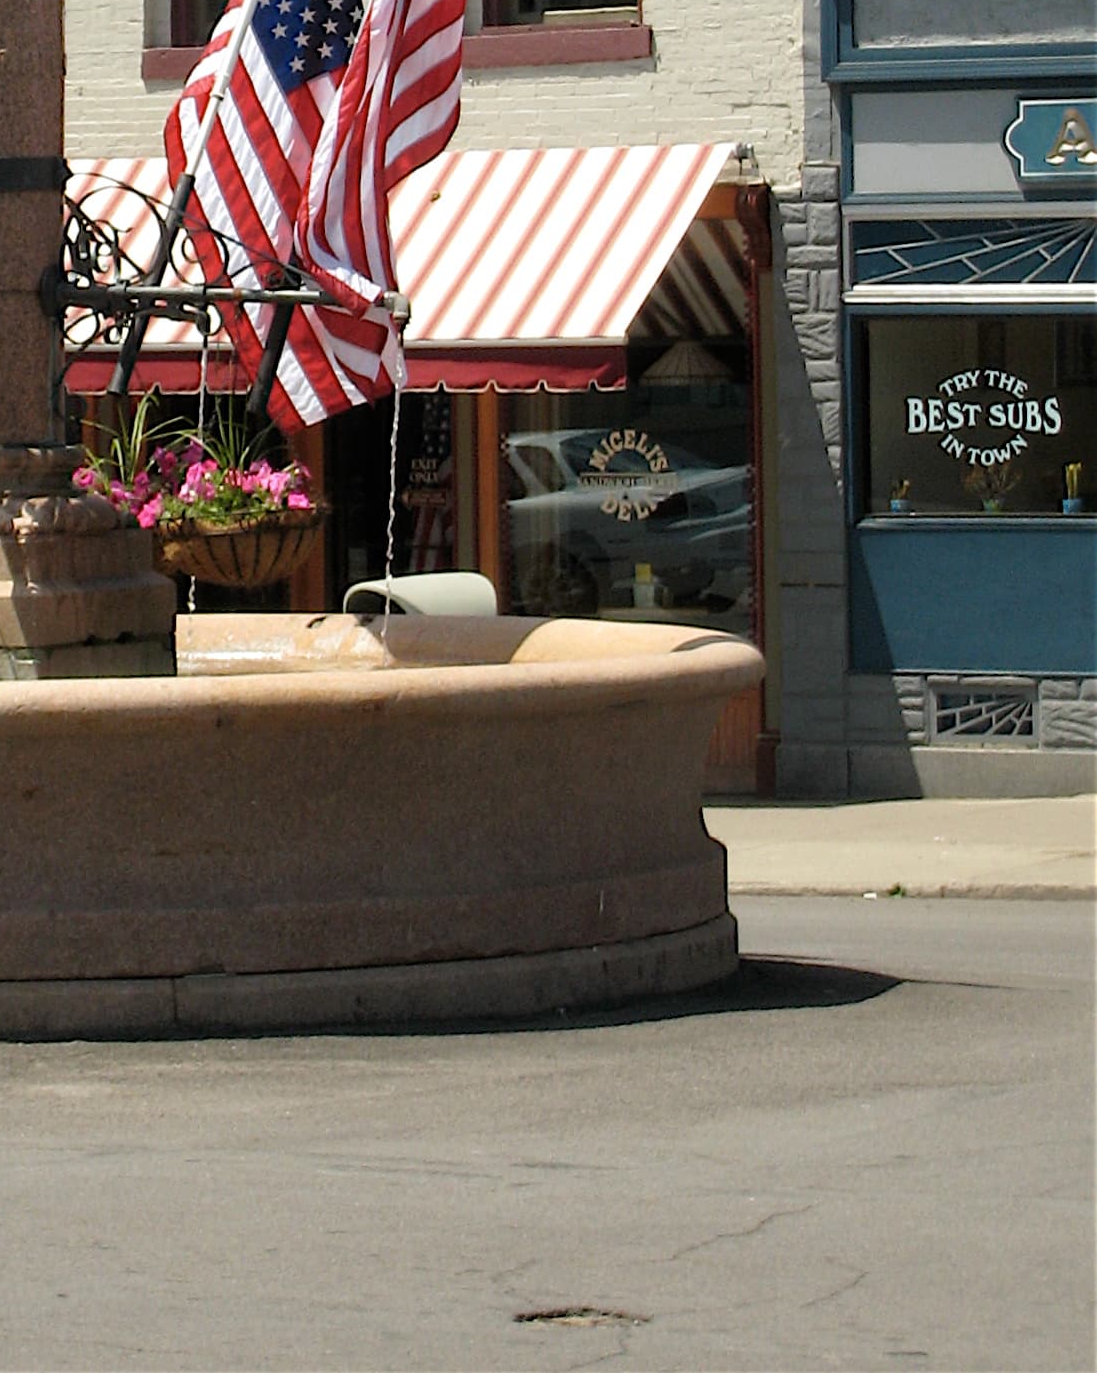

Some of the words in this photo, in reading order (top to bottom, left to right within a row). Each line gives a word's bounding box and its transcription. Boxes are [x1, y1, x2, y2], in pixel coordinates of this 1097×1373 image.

[939, 370, 981, 398] TRY
[984, 369, 1029, 399] THE
[907, 397, 983, 434] BEST
[988, 396, 1062, 435] SUBS
[411, 458, 438, 470] EXIT
[588, 429, 669, 473] MICELI'S
[940, 433, 965, 459] IN
[966, 433, 1029, 466] TOWN
[600, 493, 658, 522] DELI
